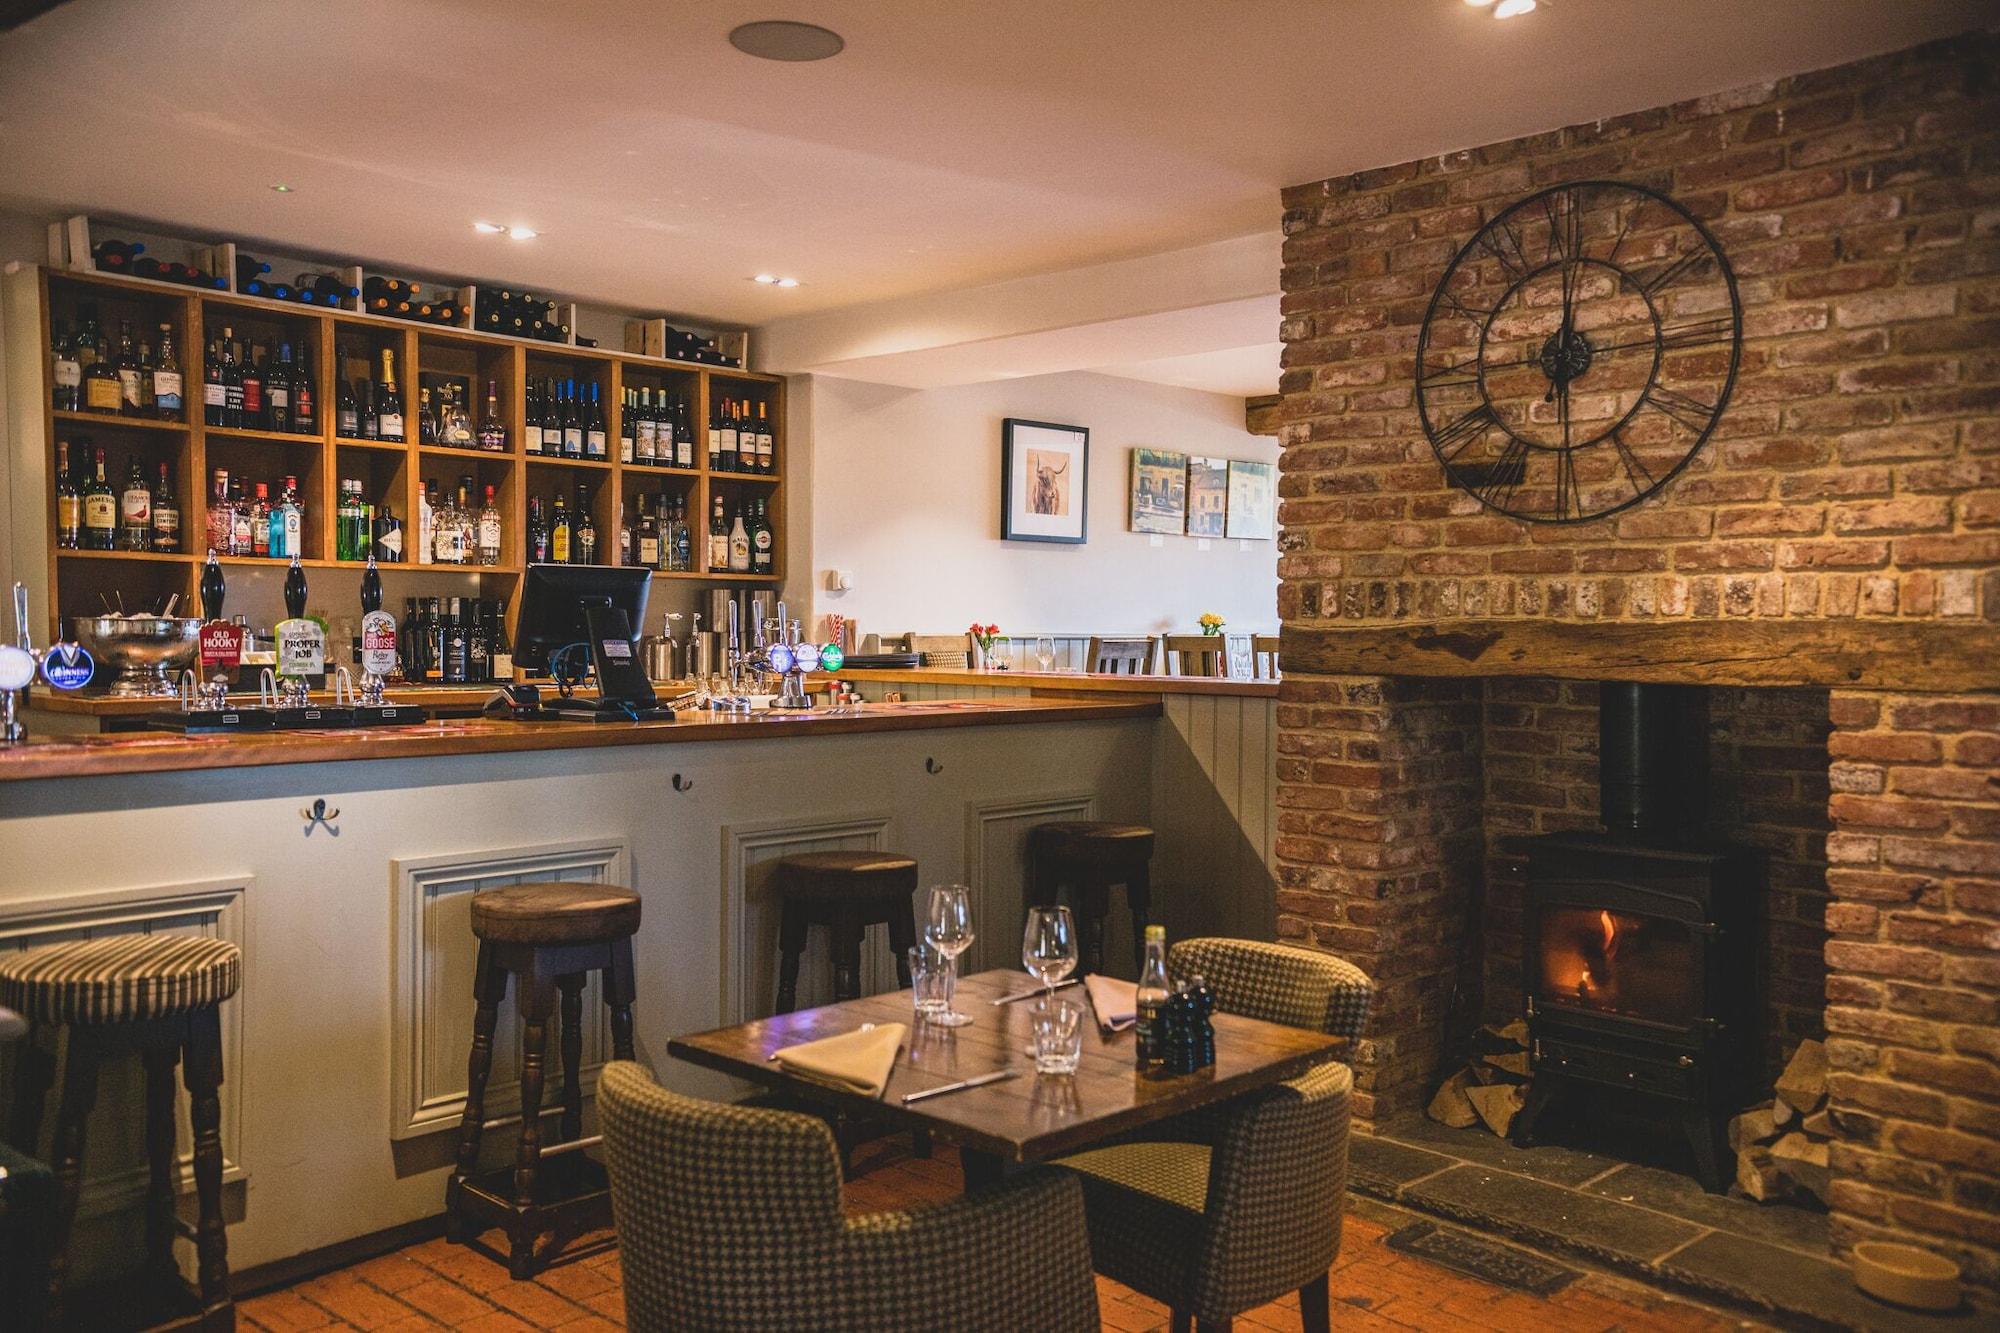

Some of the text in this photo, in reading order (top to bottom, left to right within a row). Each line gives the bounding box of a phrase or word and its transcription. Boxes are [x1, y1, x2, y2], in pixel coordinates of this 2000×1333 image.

[213, 631, 230, 639] OLD
[204, 638, 239, 648] HOOKY
[285, 640, 320, 649] PROPER
[366, 638, 395, 649] GOOSE
[295, 650, 312, 659] JOB
[50, 665, 89, 677] GUINNESS
